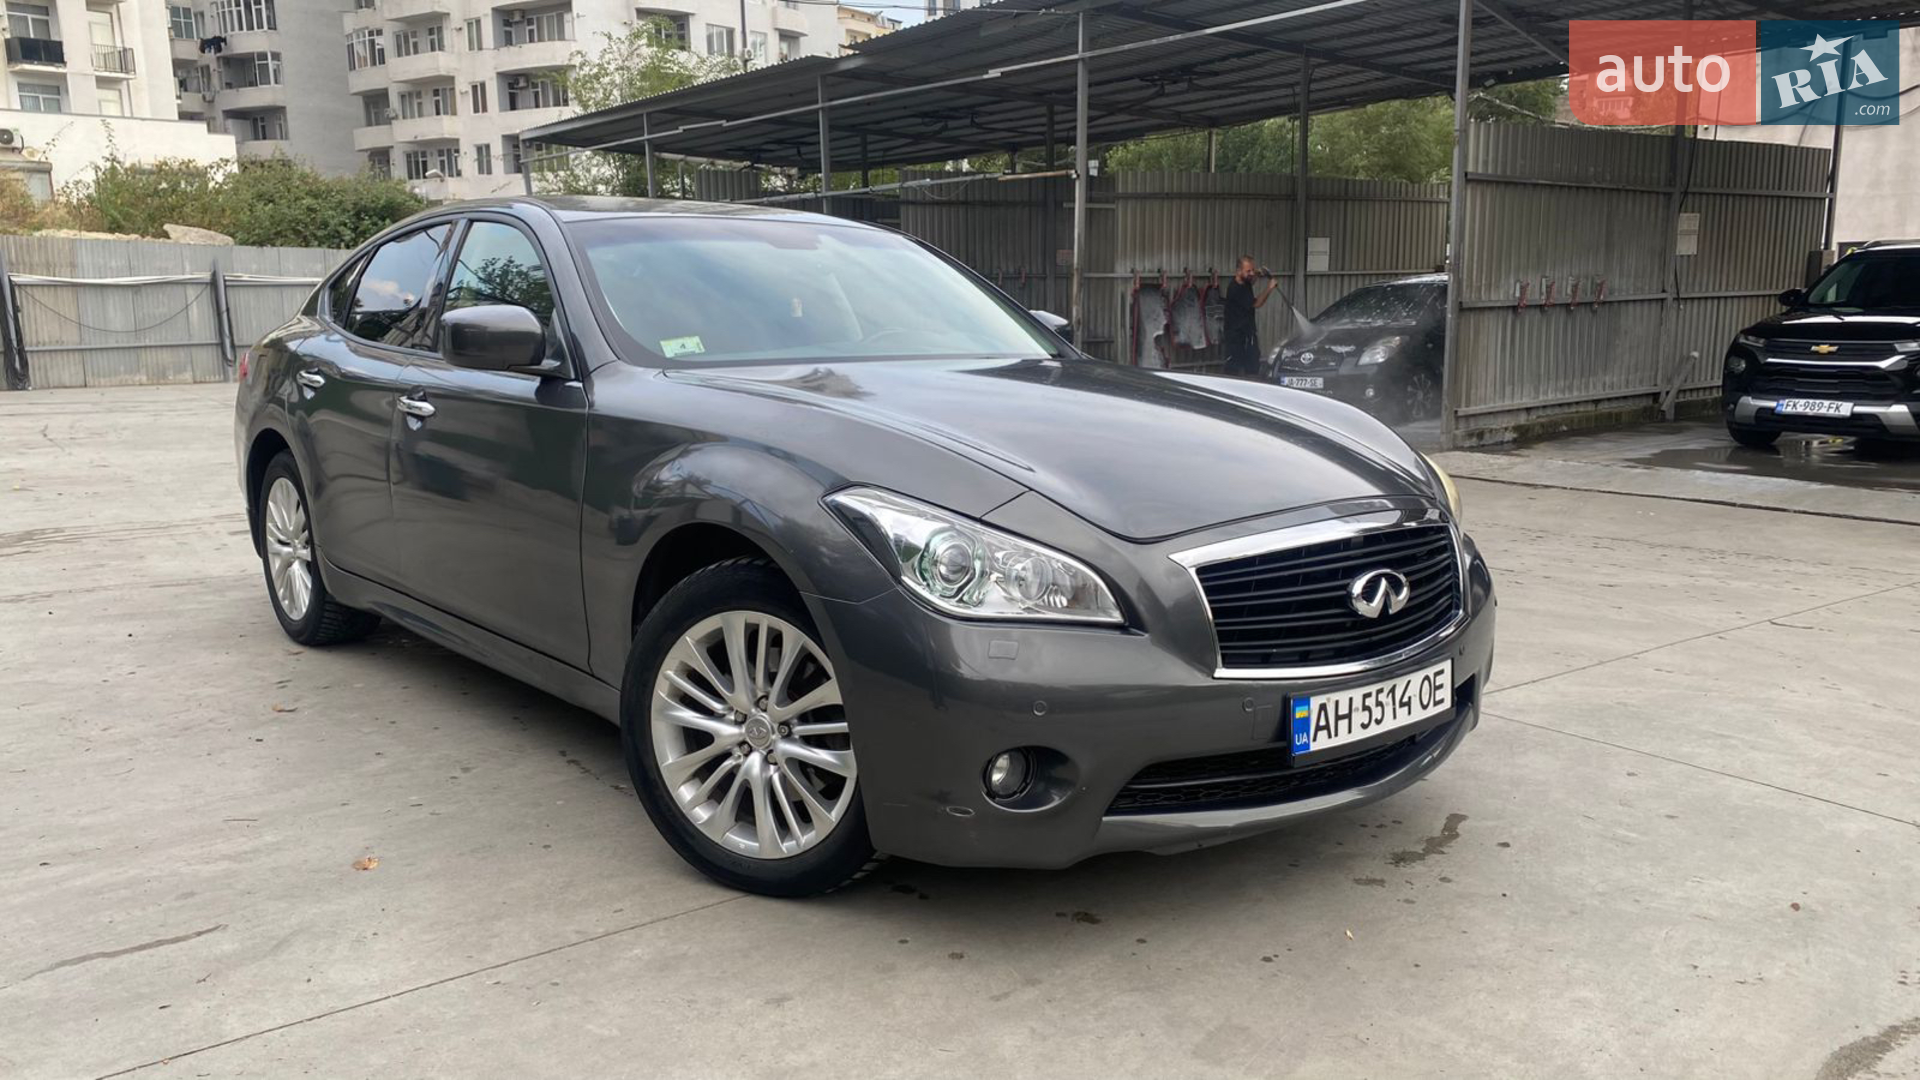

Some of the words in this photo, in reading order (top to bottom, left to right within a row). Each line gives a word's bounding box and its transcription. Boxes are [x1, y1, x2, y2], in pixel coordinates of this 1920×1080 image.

[1785, 400, 1843, 413] FK-989-FK
[1312, 697, 1354, 743] AH
[1360, 680, 1412, 730] 5514
[1419, 668, 1445, 711] OE
[1295, 733, 1309, 745] UA
